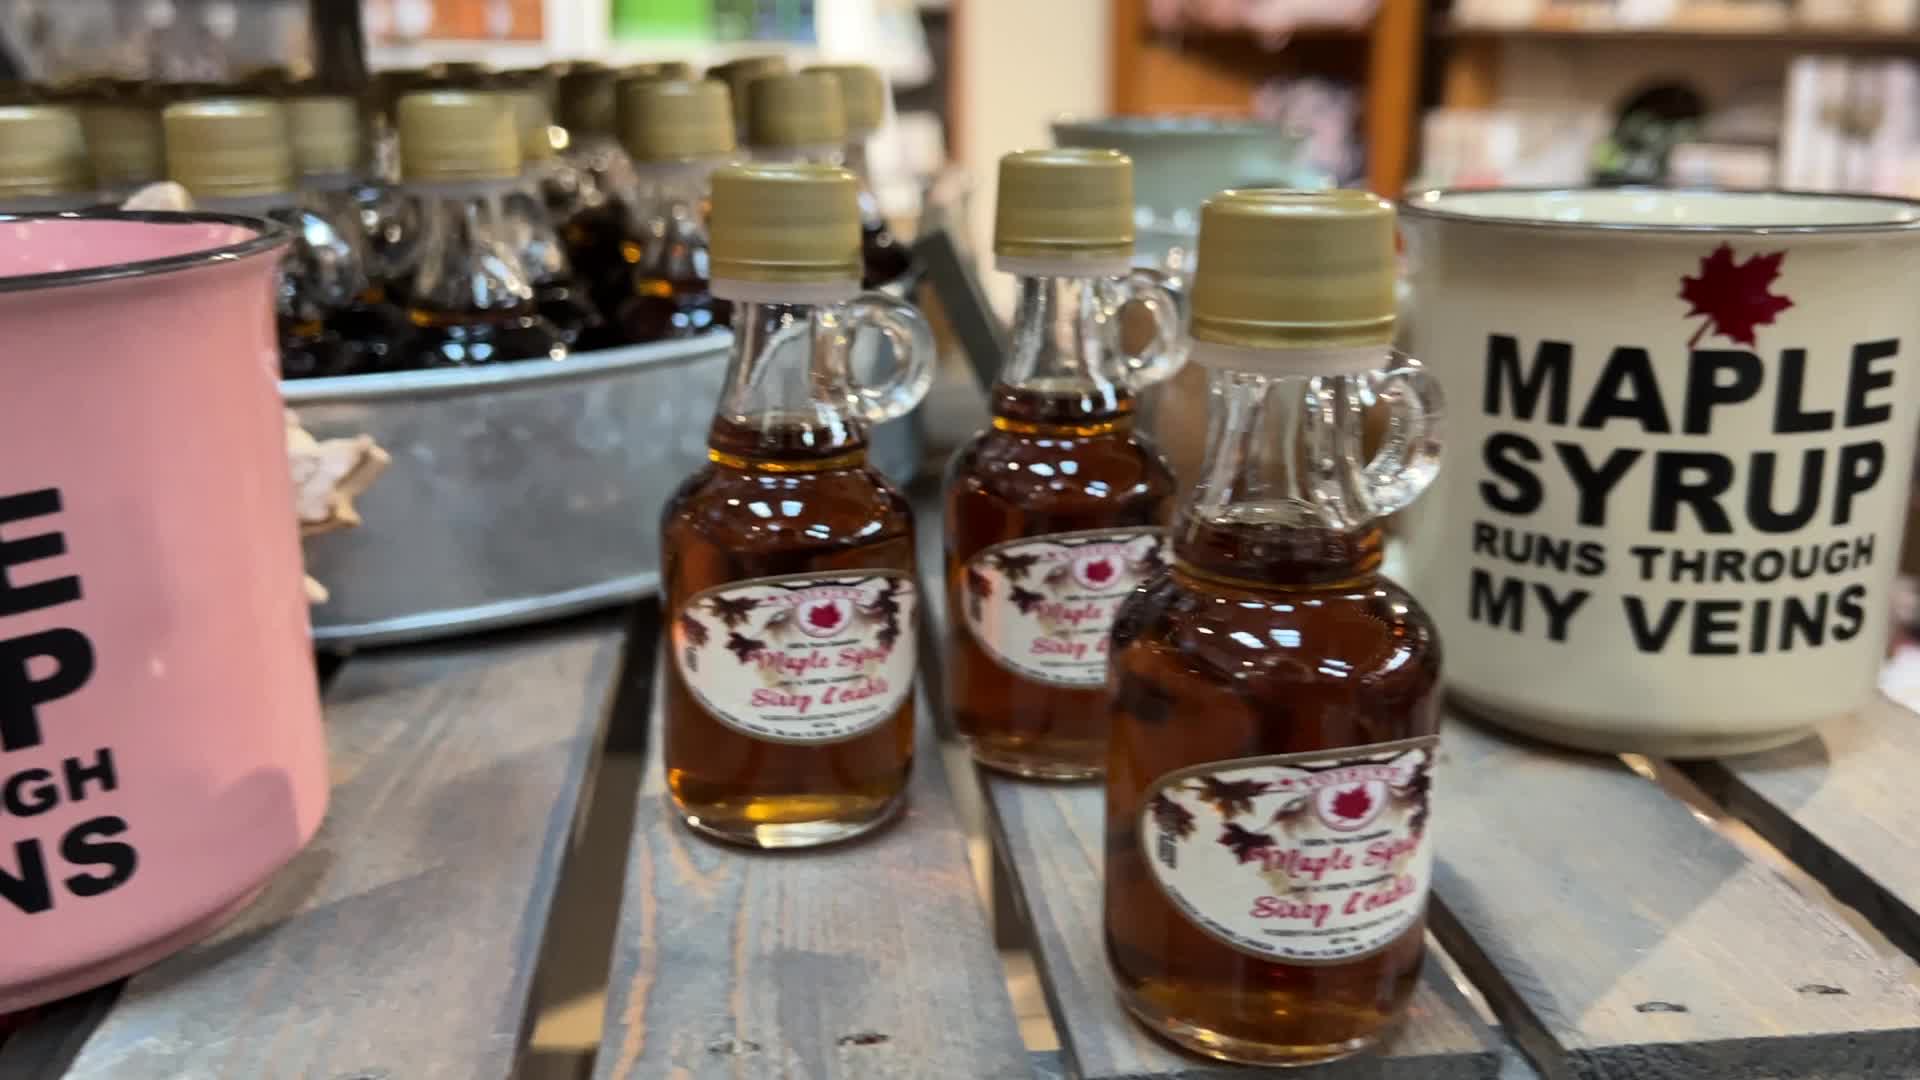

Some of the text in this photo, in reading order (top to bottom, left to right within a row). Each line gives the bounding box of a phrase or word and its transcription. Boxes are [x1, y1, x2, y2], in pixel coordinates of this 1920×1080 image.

[1482, 333, 1899, 436] MAPLE
[1478, 432, 1885, 534] SYRUP
[1472, 521, 1876, 584] RUNS THROUGH
[1468, 568, 1867, 656] MY VEINS
